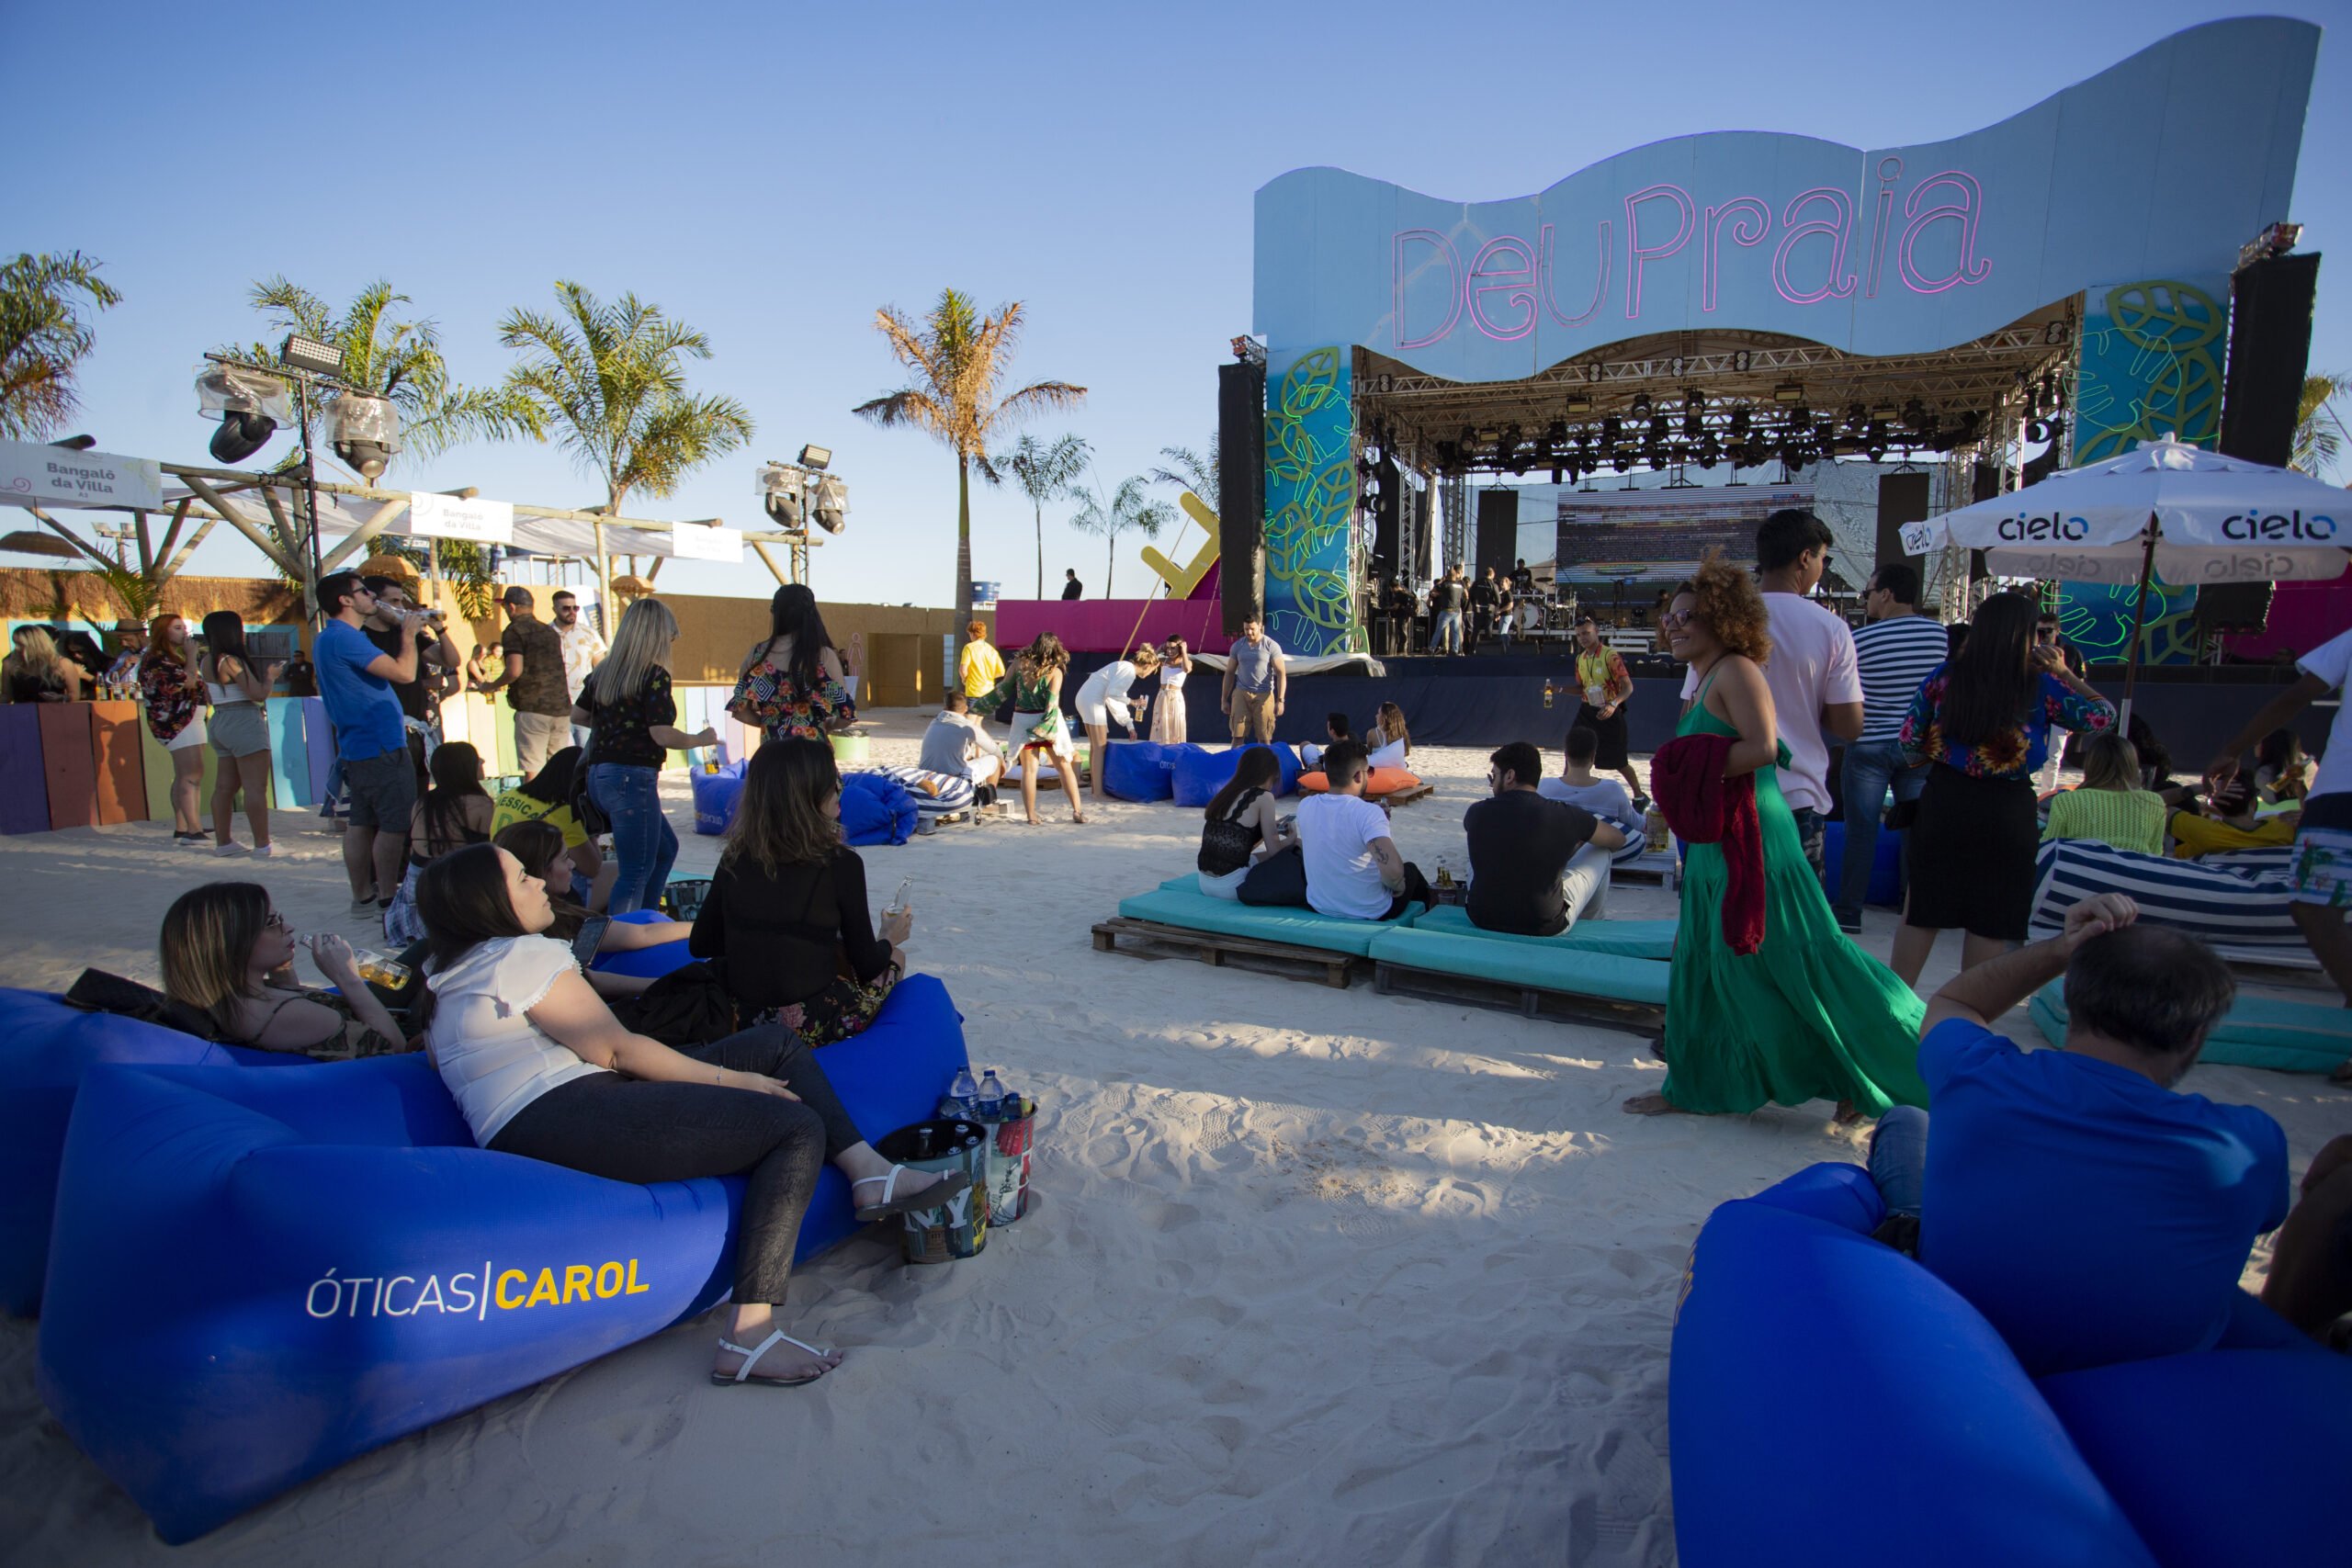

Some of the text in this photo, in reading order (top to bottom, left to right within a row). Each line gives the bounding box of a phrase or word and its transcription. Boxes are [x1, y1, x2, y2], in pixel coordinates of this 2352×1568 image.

[1624, 156, 1992, 319] Praia
[47, 462, 116, 480] Bangalô
[51, 477, 114, 493] da Villa
[1997, 512, 2089, 540] cielo
[2222, 509, 2337, 540] cielo
[306, 1258, 650, 1317] ÓTICAS CAROL
